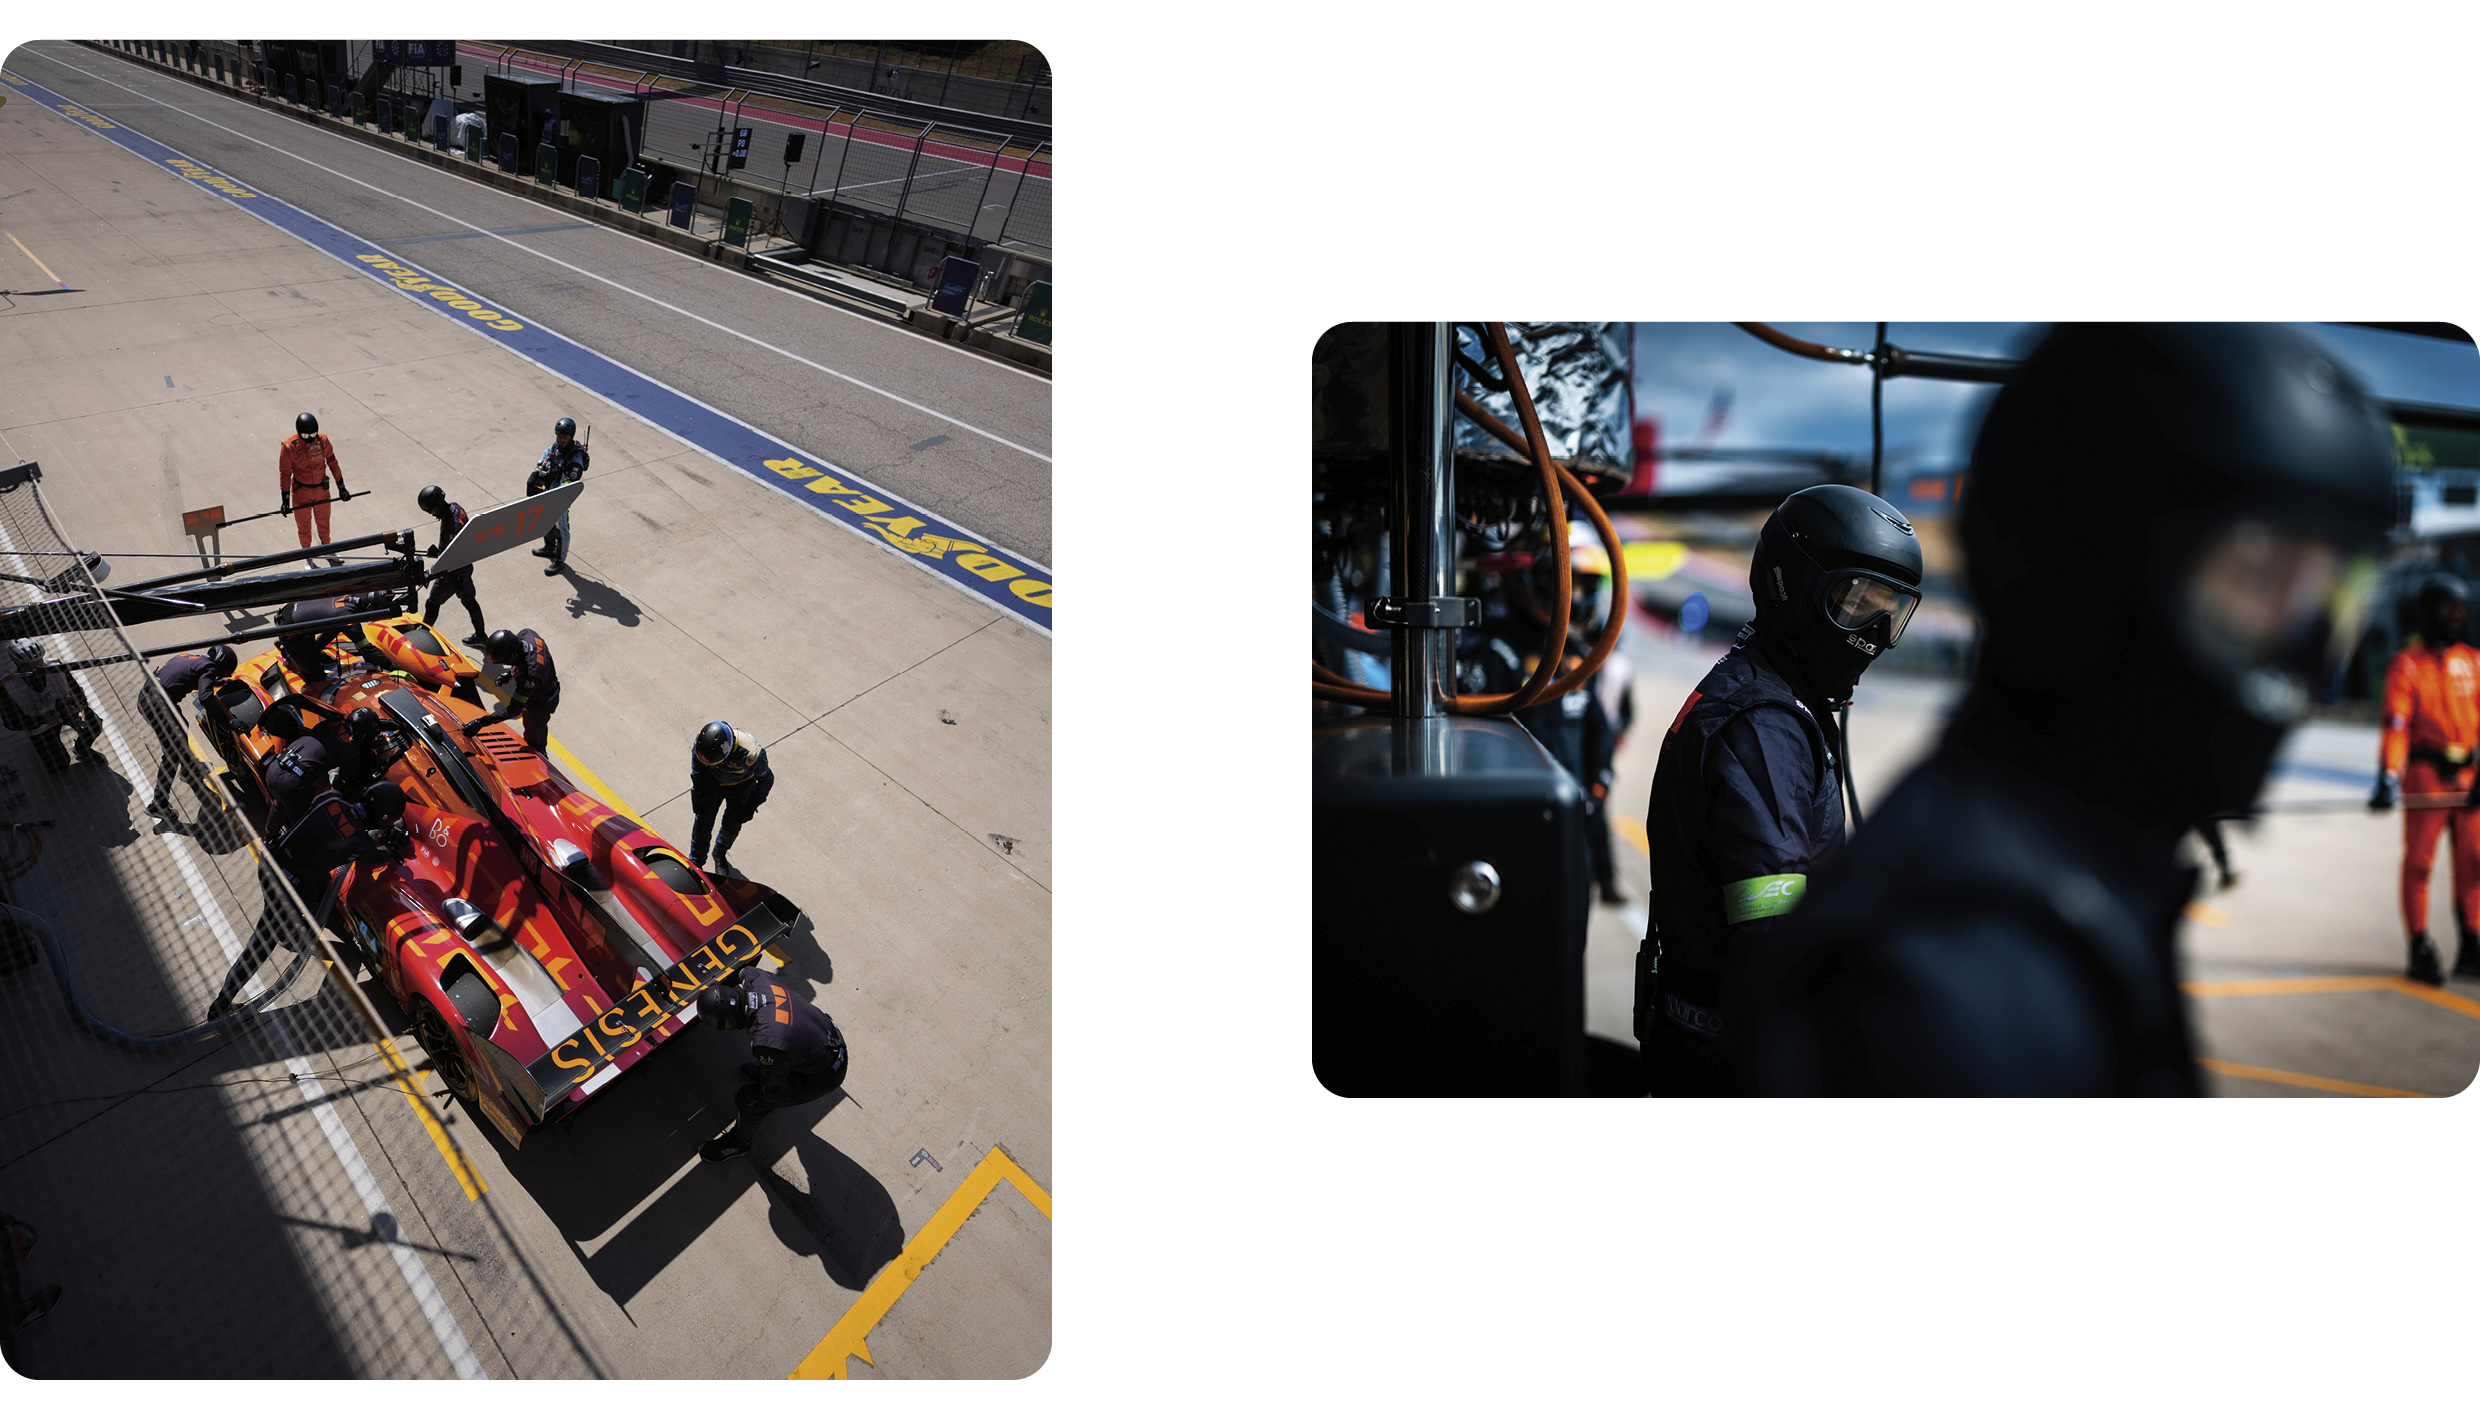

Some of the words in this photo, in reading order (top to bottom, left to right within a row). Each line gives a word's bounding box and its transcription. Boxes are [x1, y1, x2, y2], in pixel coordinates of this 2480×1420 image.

[407, 42, 426, 56] FIA
[356, 254, 524, 331] GOODYEAR
[1027, 314, 1053, 328] ROLEX
[514, 504, 546, 537] 17
[1736, 879, 1796, 904] WEC
[551, 924, 762, 1083] GENESIS
